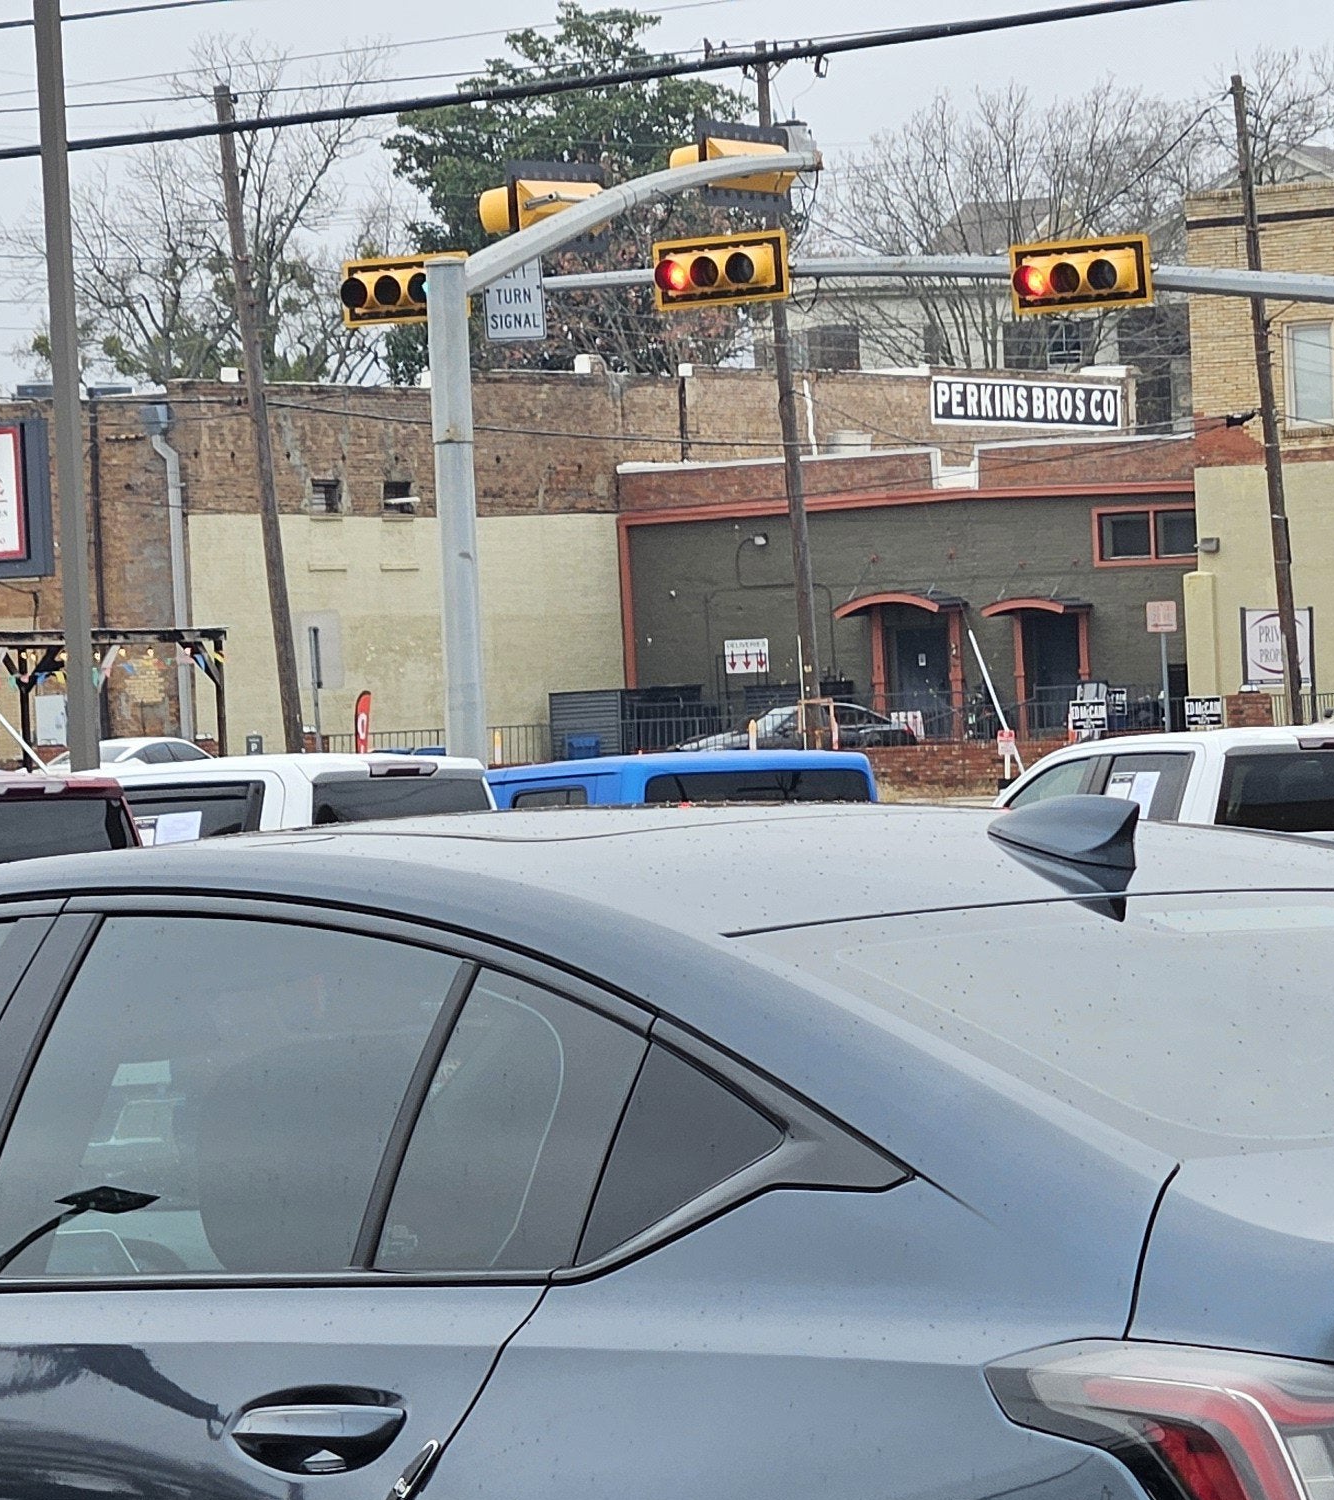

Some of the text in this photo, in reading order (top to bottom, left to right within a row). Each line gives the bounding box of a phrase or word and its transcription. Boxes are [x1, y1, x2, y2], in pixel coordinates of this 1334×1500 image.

[495, 288, 532, 305] TURN
[490, 313, 541, 330] SIGNAL
[935, 382, 1116, 422] PERKINS BROS CO
